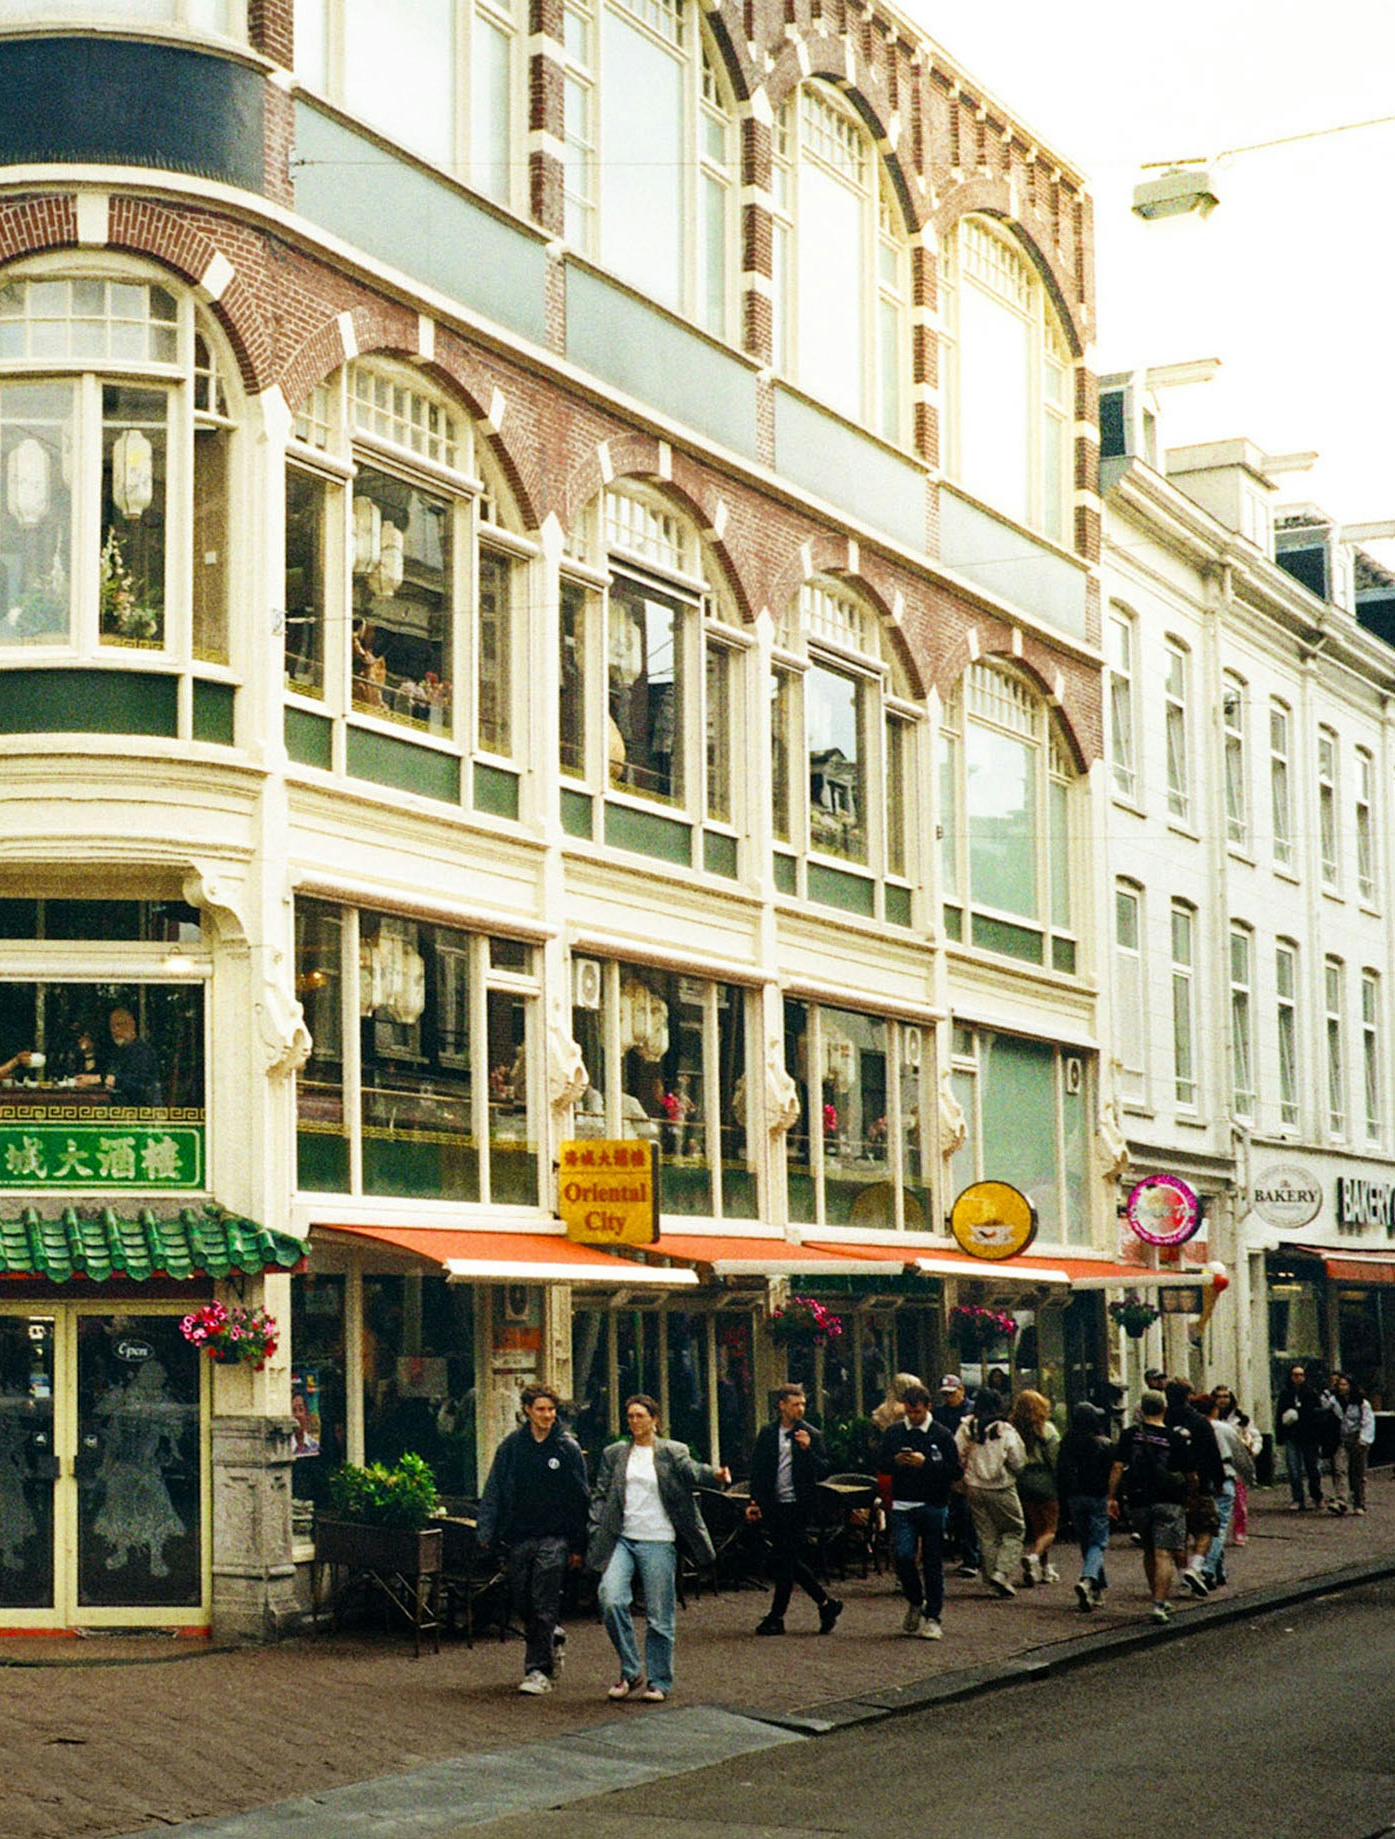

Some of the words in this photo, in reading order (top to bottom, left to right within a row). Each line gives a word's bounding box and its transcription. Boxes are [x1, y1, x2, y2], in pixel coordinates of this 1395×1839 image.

[564, 1183, 647, 1203] Oriental
[1254, 1189, 1318, 1202] BAKERY
[585, 1211, 627, 1236] City
[118, 1342, 148, 1358] Open
